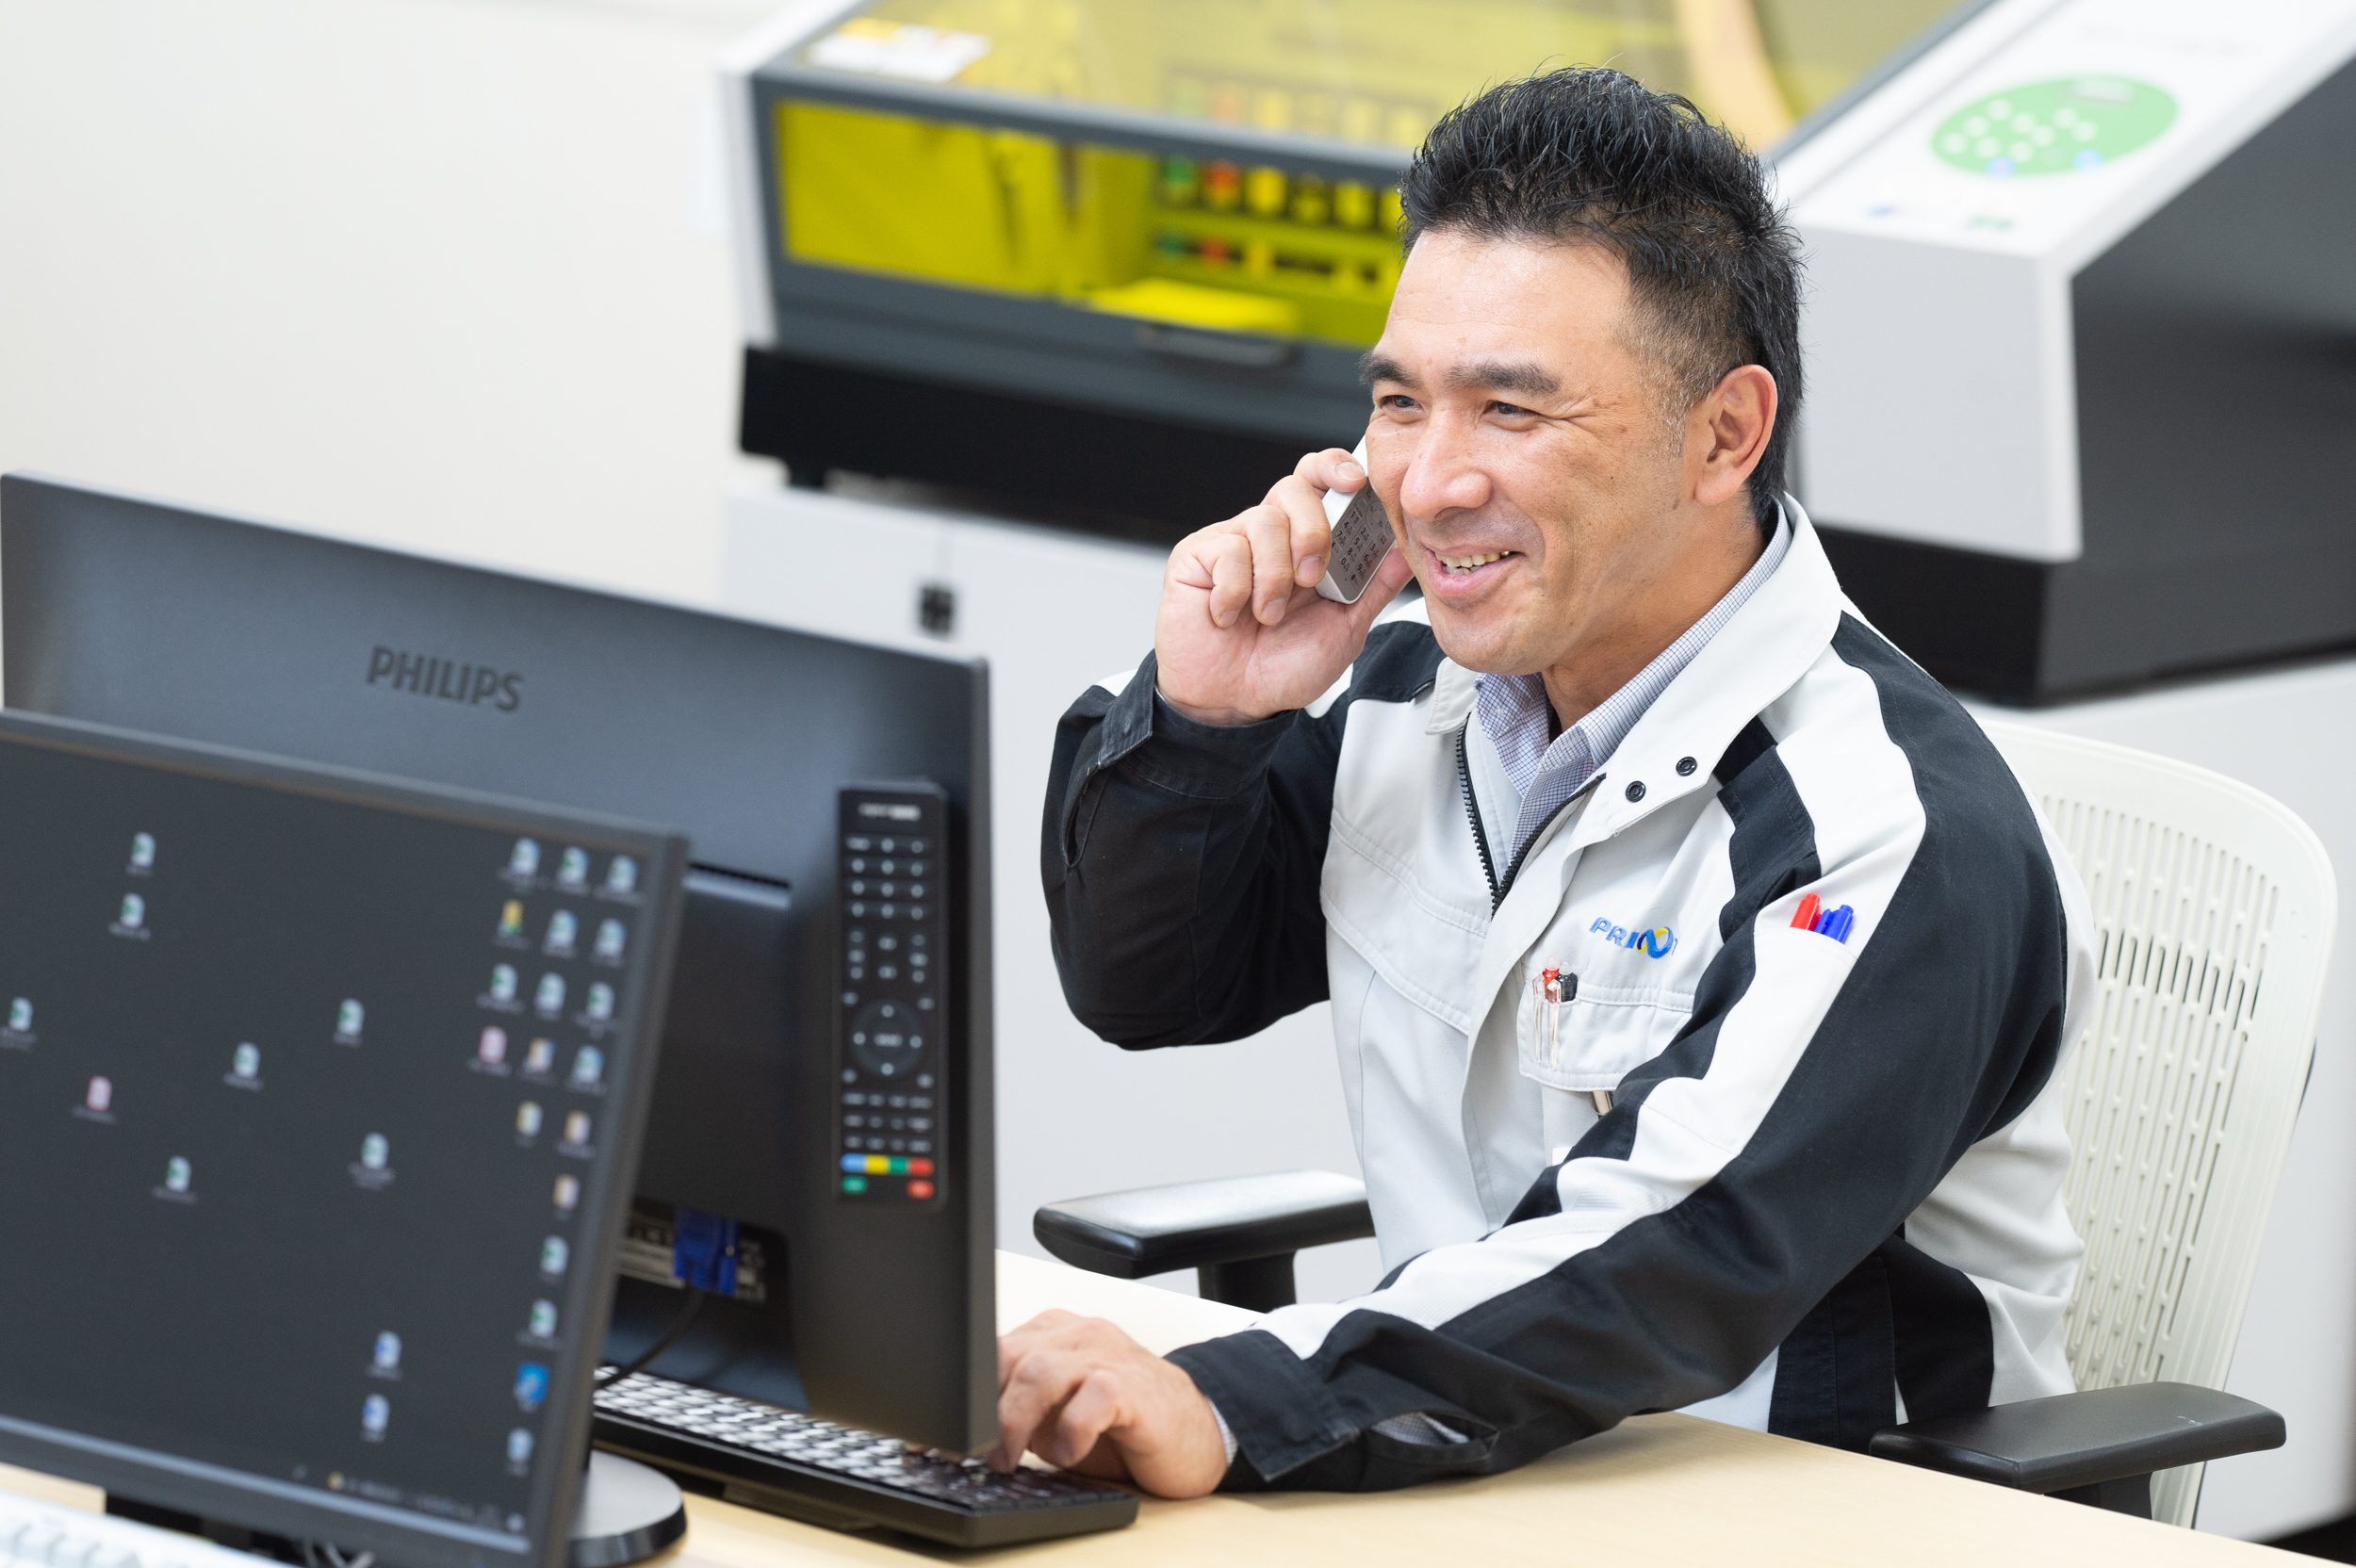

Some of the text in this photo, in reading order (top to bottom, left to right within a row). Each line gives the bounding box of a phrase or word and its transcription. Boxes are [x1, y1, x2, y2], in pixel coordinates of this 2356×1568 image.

[1336, 530, 1343, 538] 7
[1360, 527, 1366, 535] 2
[1353, 537, 1360, 546] 5
[1369, 543, 1376, 551] 3
[1347, 547, 1353, 556] 8
[1340, 557, 1347, 565] 0
[1363, 553, 1369, 562] 6
[1357, 563, 1363, 571] 9
[366, 644, 525, 713] PHILIPS
